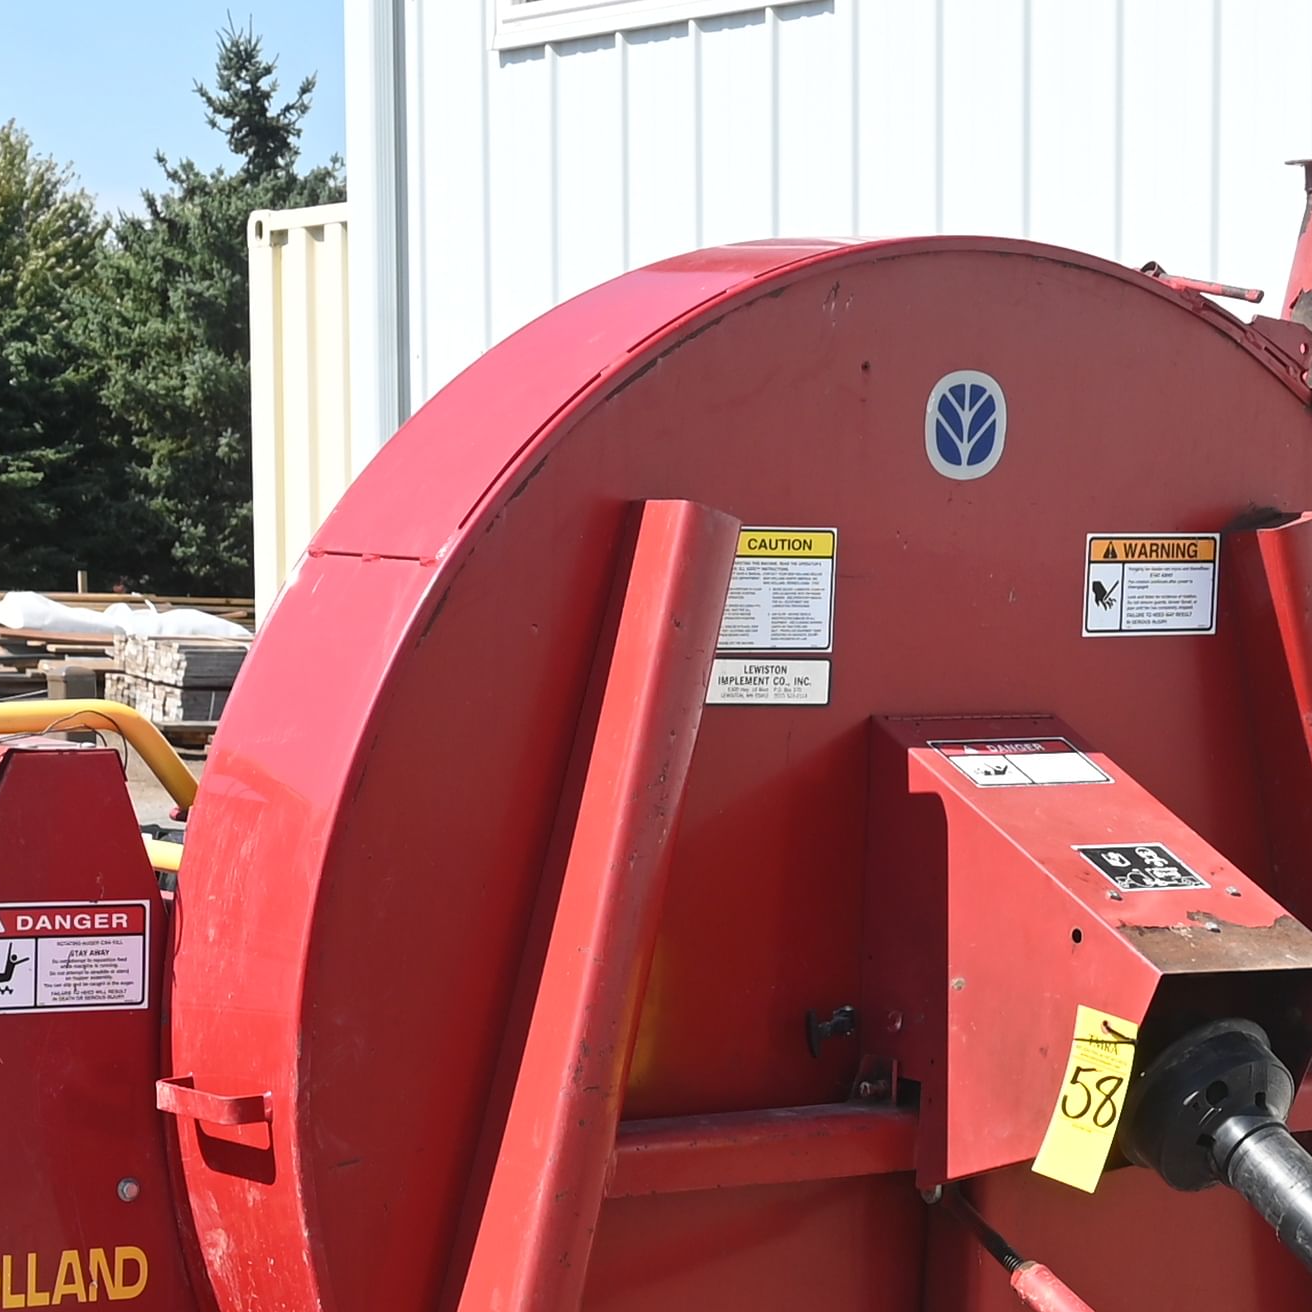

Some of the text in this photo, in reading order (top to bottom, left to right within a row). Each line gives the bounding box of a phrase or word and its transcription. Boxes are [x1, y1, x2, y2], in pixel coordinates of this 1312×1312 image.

[747, 538, 813, 551] CAUTION
[1123, 542, 1198, 559] WARNING
[743, 664, 788, 675] LEWISTON
[718, 676, 769, 686] IMPLEMENT
[986, 742, 1045, 753] DANGER
[15, 913, 129, 931] DANGER
[1061, 1066, 1124, 1128] 58
